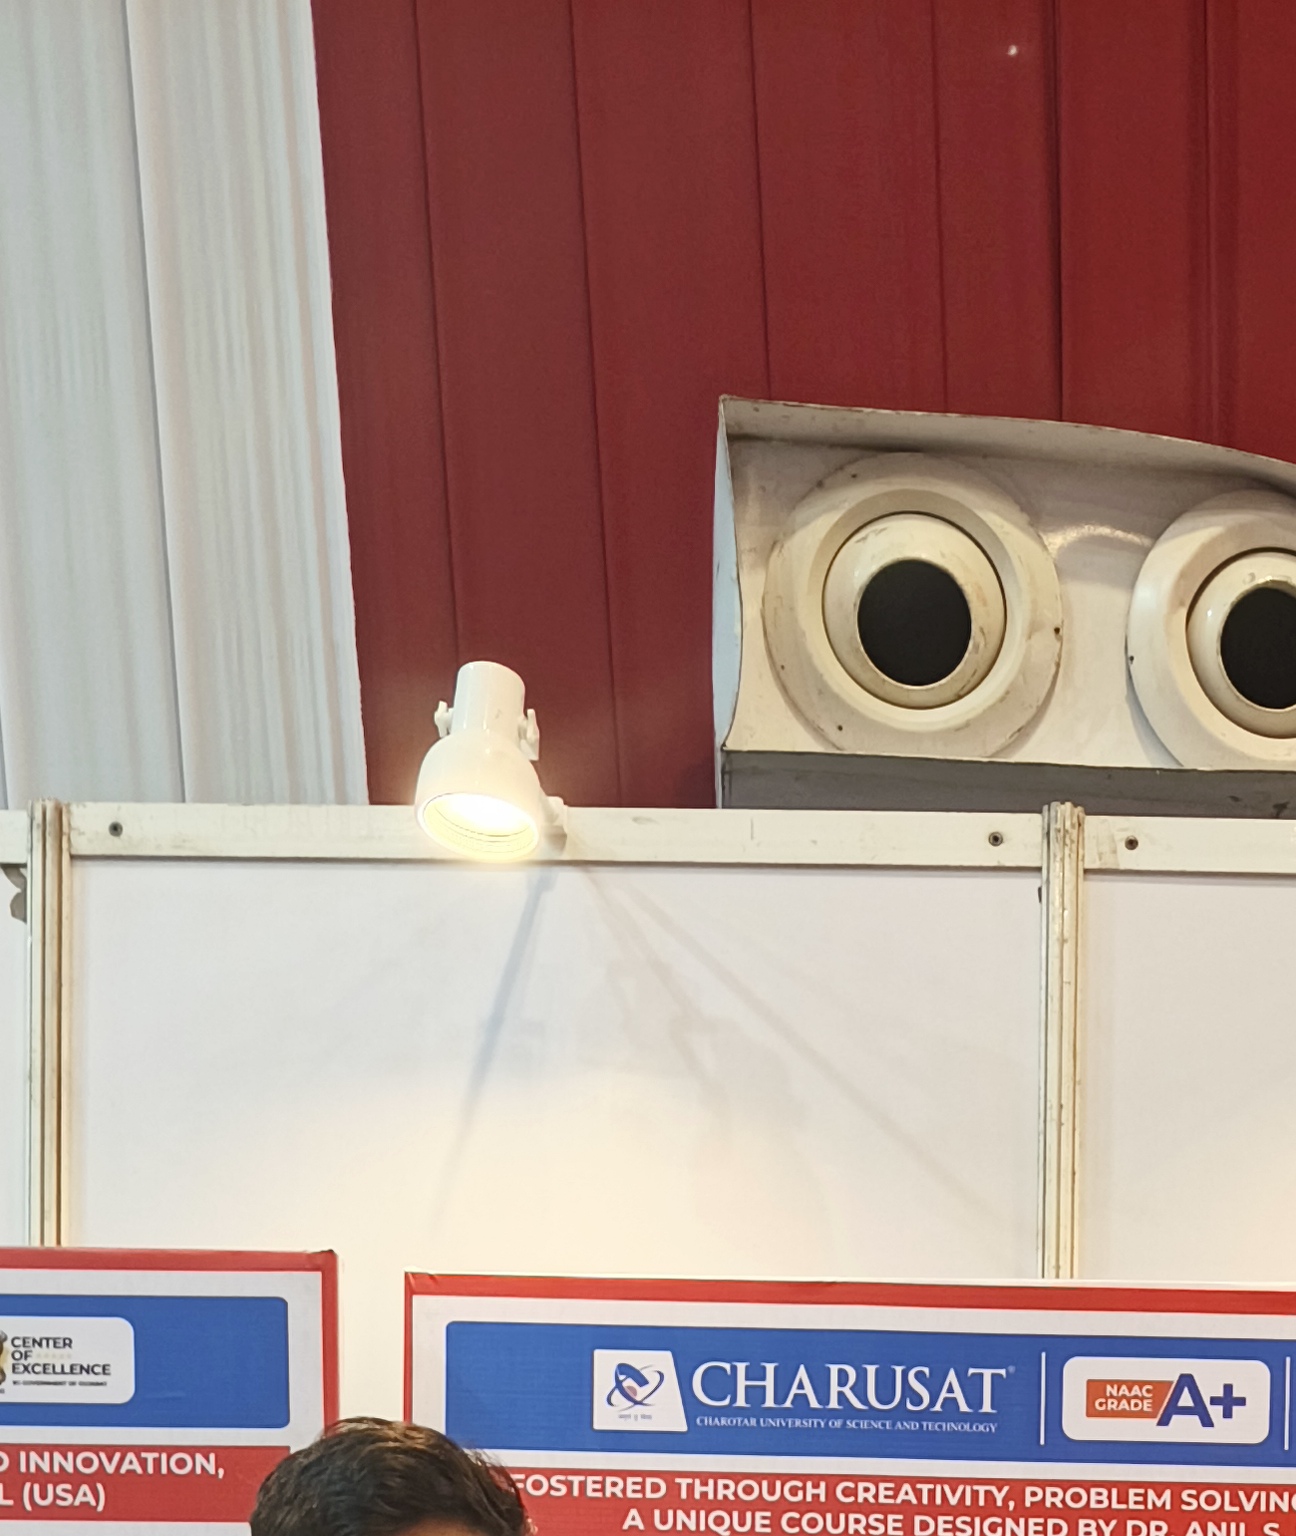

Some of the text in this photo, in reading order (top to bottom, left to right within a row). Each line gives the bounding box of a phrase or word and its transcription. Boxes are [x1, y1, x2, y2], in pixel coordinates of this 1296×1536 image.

[11, 1336, 73, 1349] CENTER
[11, 1349, 33, 1361] OF
[11, 1363, 112, 1376] EXCELLENCE
[692, 1361, 1007, 1414] CHARUSAT
[1105, 1383, 1153, 1398] NAAC
[1094, 1398, 1153, 1413] GRADE
[1156, 1373, 1247, 1428] A+
[696, 1416, 998, 1433] CHAROTAR UNIVERSITY OF SCIENCE AND TECHNOLOGY
[19, 1451, 225, 1479] INNOVATION,
[23, 1482, 106, 1512] (USA)
[675, 1478, 827, 1503] THROUGH
[836, 1481, 1016, 1511] CREATIVITY,
[1025, 1486, 1172, 1510] PROBLEM
[622, 1508, 645, 1530] A
[654, 1509, 772, 1536] UNIQUE
[780, 1512, 904, 1536] COURSE
